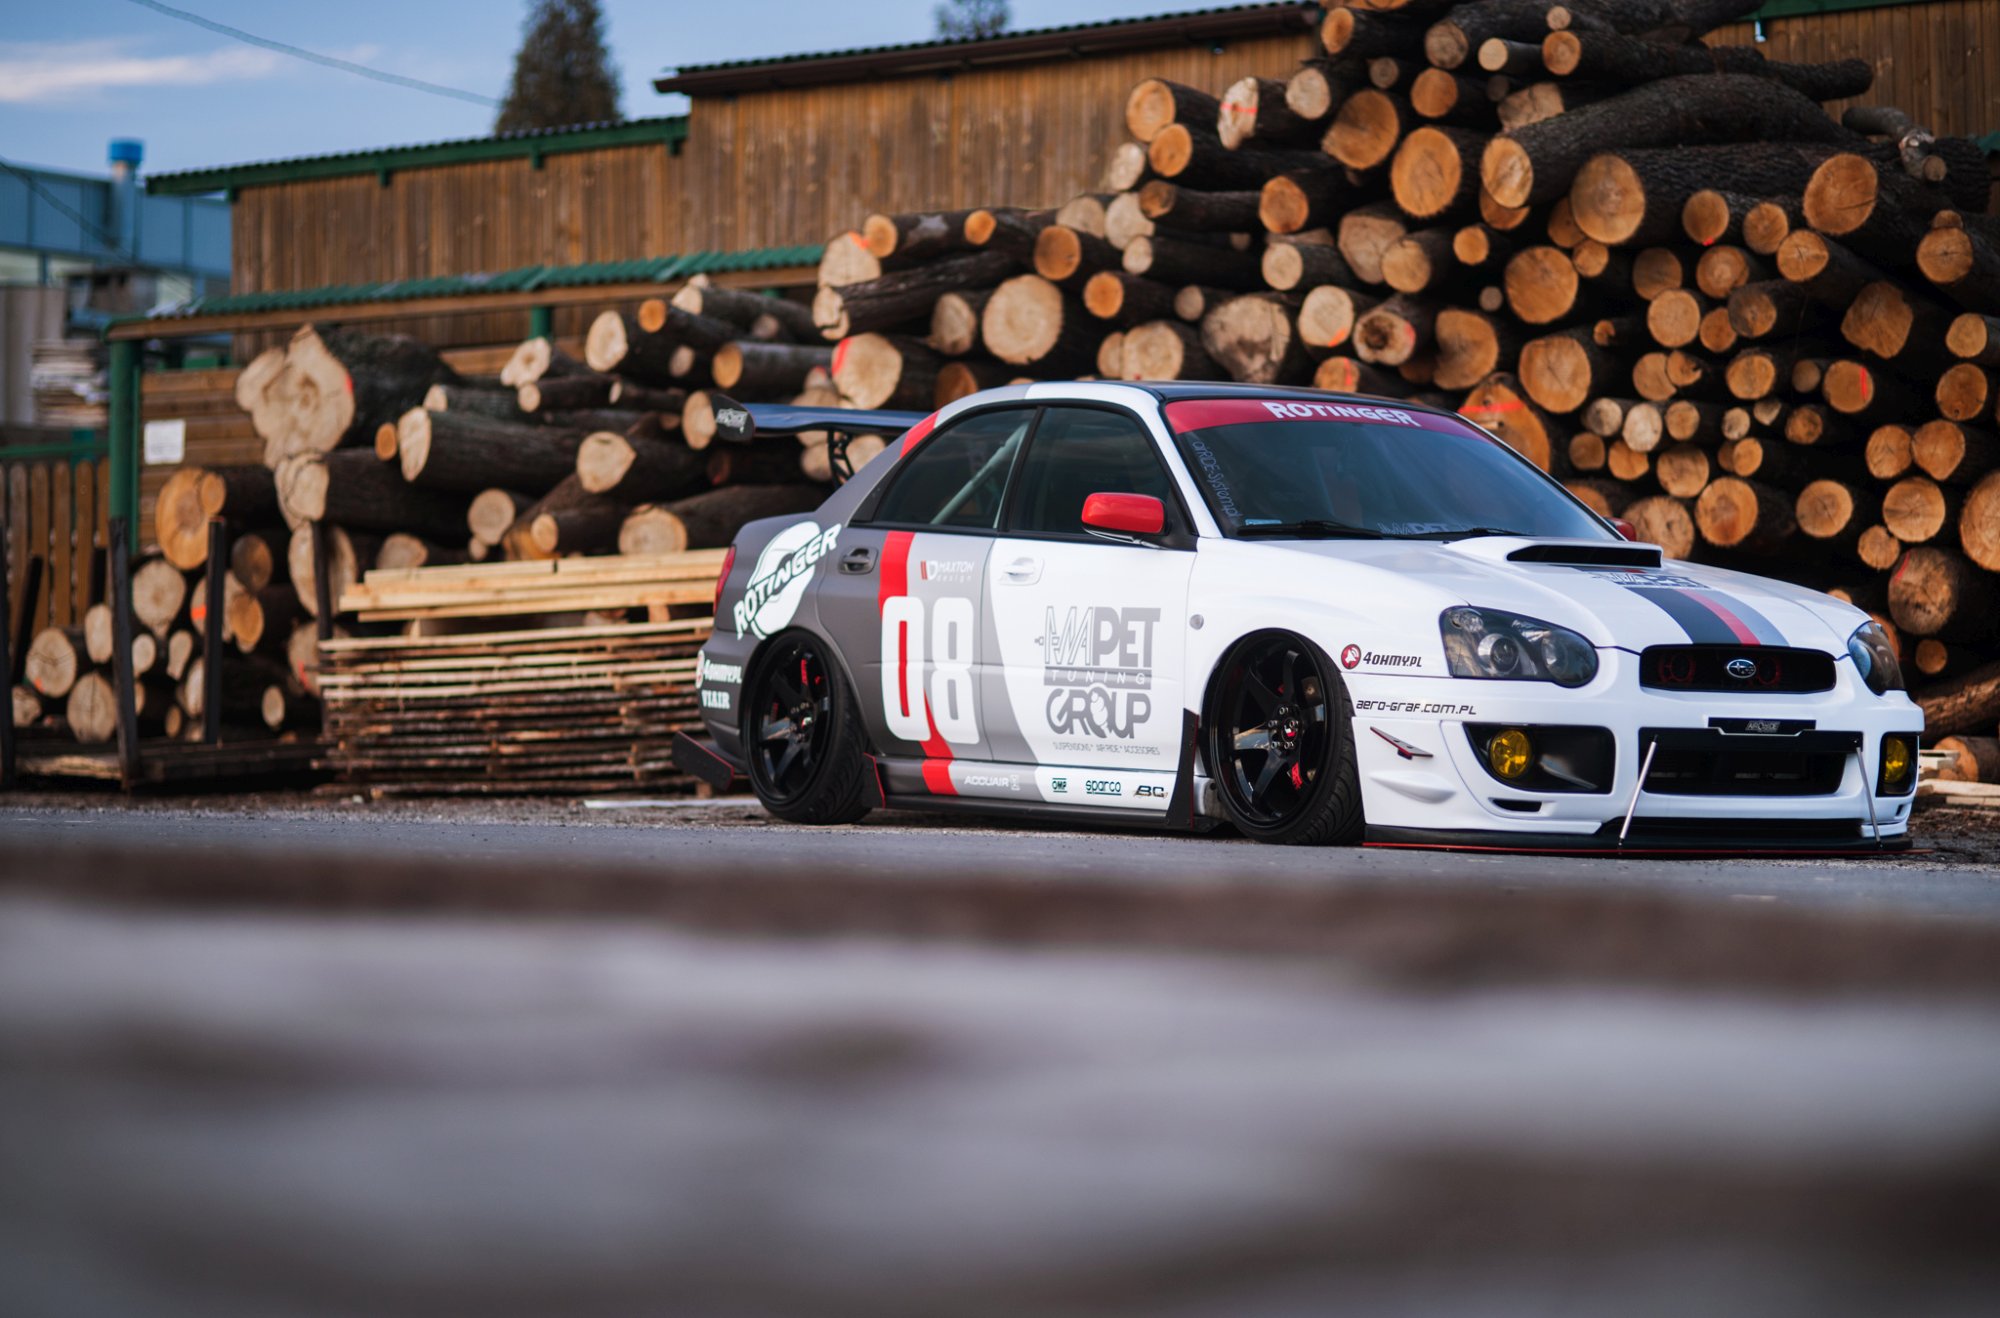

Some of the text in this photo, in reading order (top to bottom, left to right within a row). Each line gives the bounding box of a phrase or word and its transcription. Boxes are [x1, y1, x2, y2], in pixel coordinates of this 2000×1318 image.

[1261, 402, 1422, 427] ROTINGER
[938, 561, 975, 574] MAXTON
[734, 523, 842, 640] ROTINGER
[1044, 606, 1161, 668] MAPET
[881, 596, 980, 744] 08
[1051, 670, 1146, 686] TUNING
[1046, 686, 1151, 739] GROUP
[964, 775, 1009, 788] ACCUAIR
[1052, 779, 1067, 791] OMP
[1086, 780, 1121, 794] sparco
